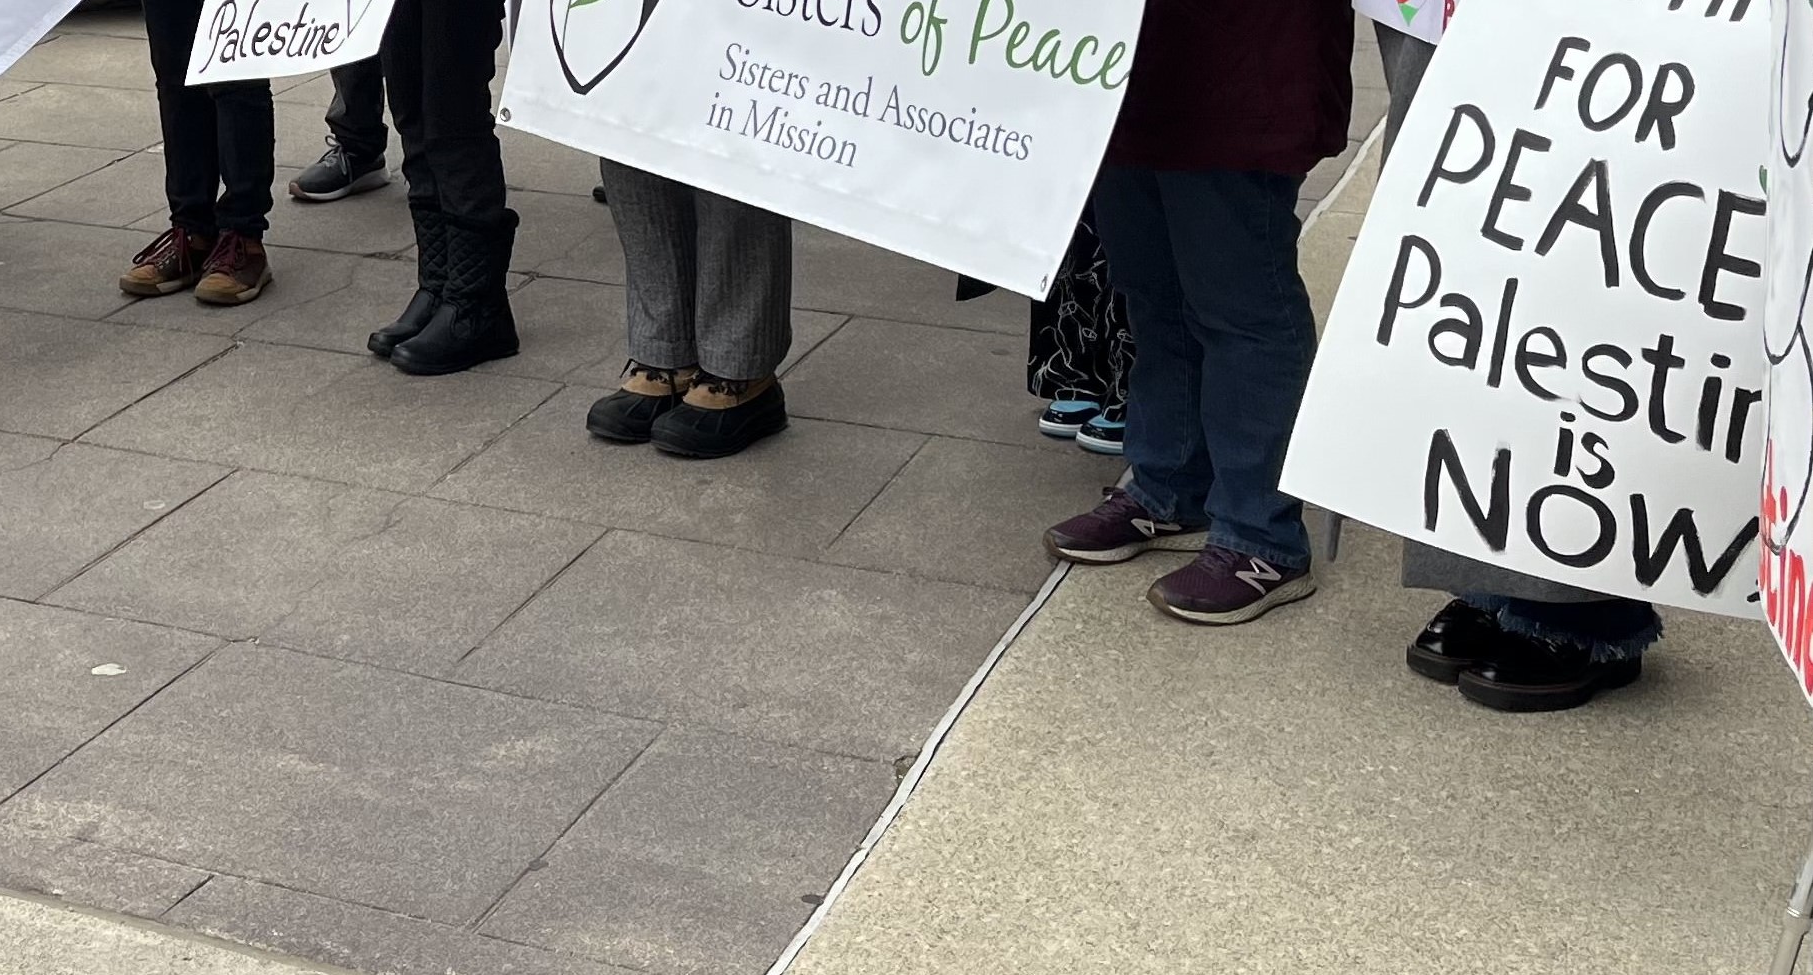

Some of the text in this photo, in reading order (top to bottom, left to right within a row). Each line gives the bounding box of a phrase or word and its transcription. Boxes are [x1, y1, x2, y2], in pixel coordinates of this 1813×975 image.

[705, 91, 858, 168] in Mission
[719, 42, 1033, 161] Sisters and Associates
[1533, 36, 1696, 152] FOR
[1416, 103, 1767, 321] PEACE
[1553, 411, 1616, 490] is
